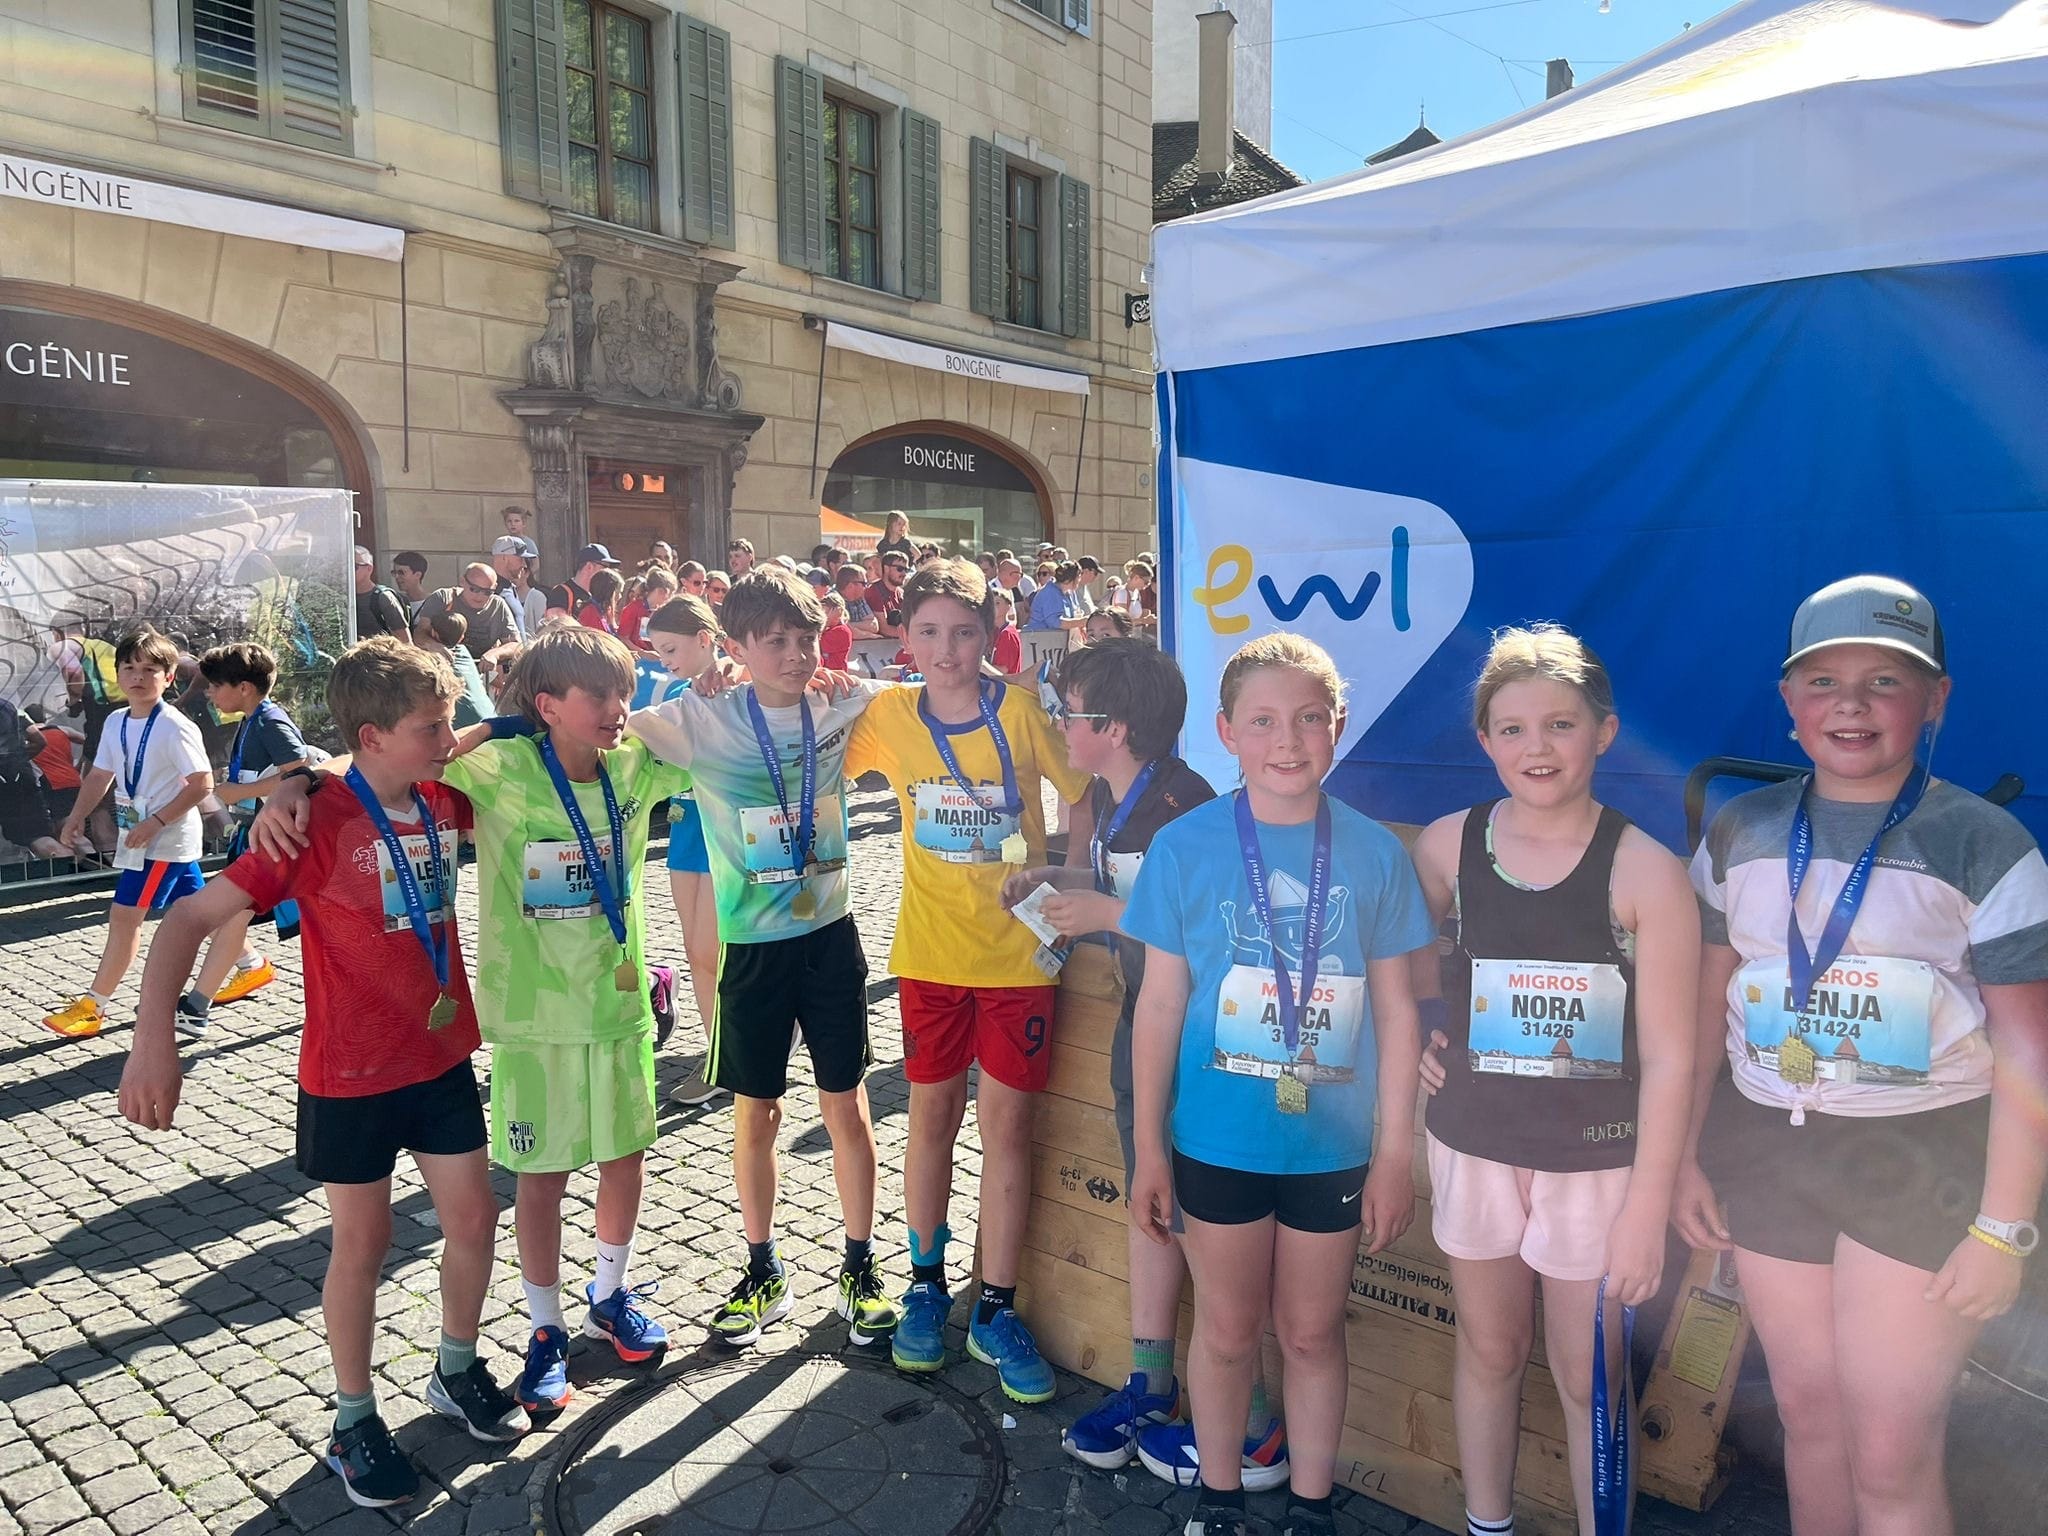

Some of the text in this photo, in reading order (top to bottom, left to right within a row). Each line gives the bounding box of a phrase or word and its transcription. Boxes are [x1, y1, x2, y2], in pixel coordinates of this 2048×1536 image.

[5, 341, 131, 385] GÉNIE
[904, 446, 976, 472] BONGÉNIE
[1192, 525, 1411, 634] ewl
[769, 808, 820, 826] MIGRS
[935, 808, 1002, 826] MARIUS
[950, 827, 984, 838] 31421
[408, 841, 450, 858] MIGOS
[559, 845, 611, 862] MIGOS
[416, 858, 451, 881] LEN
[1873, 856, 1928, 871] ercrombie
[423, 878, 450, 894] 310
[569, 881, 597, 893] 3142
[1508, 974, 1589, 992] MIGROS
[1787, 965, 1879, 988] ROS
[1261, 982, 1335, 1003] MOS
[1512, 994, 1586, 1022] NORA
[1024, 1015, 1046, 1057] 9
[1521, 1021, 1574, 1039] 31426
[1800, 1017, 1861, 1039] 31424
[1271, 1029, 1319, 1046] 325
[1348, 1460, 1389, 1494] FCL
